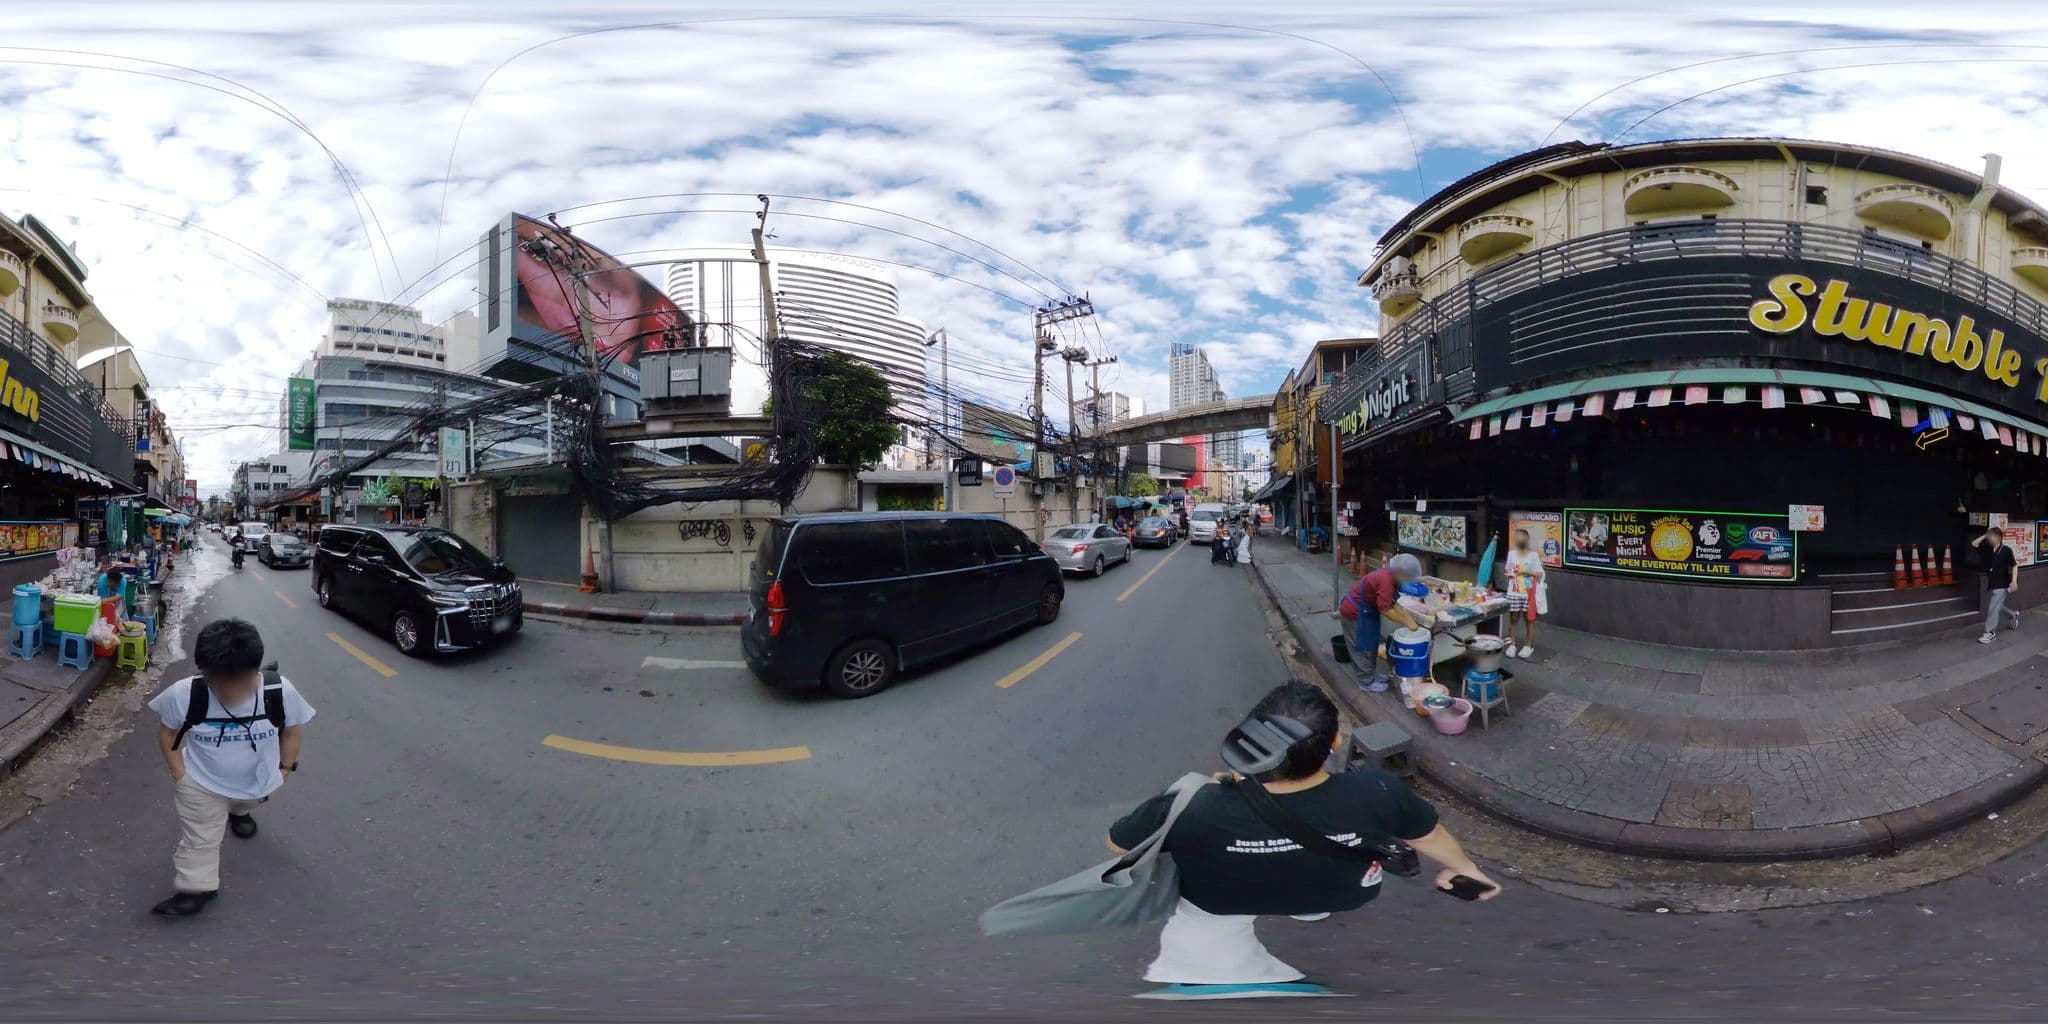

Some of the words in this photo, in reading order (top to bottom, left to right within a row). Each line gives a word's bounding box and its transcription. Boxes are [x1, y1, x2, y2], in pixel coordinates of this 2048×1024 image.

[1749, 274, 2022, 388] Stumble
[1369, 374, 1410, 419] Night
[292, 396, 307, 434] Chang
[1612, 512, 1638, 522] LIVE
[1650, 515, 1680, 529] Stumble
[1681, 518, 1694, 531] Inn
[1611, 524, 1646, 535] MUSIC
[1753, 531, 1777, 540] AFL
[1695, 552, 1722, 560] League
[1696, 545, 1722, 554] Premier
[1617, 558, 1640, 567] OPEN
[1642, 559, 1689, 571] EVERYDAY
[1691, 562, 1705, 572] TIL
[1706, 564, 1730, 574] LATE
